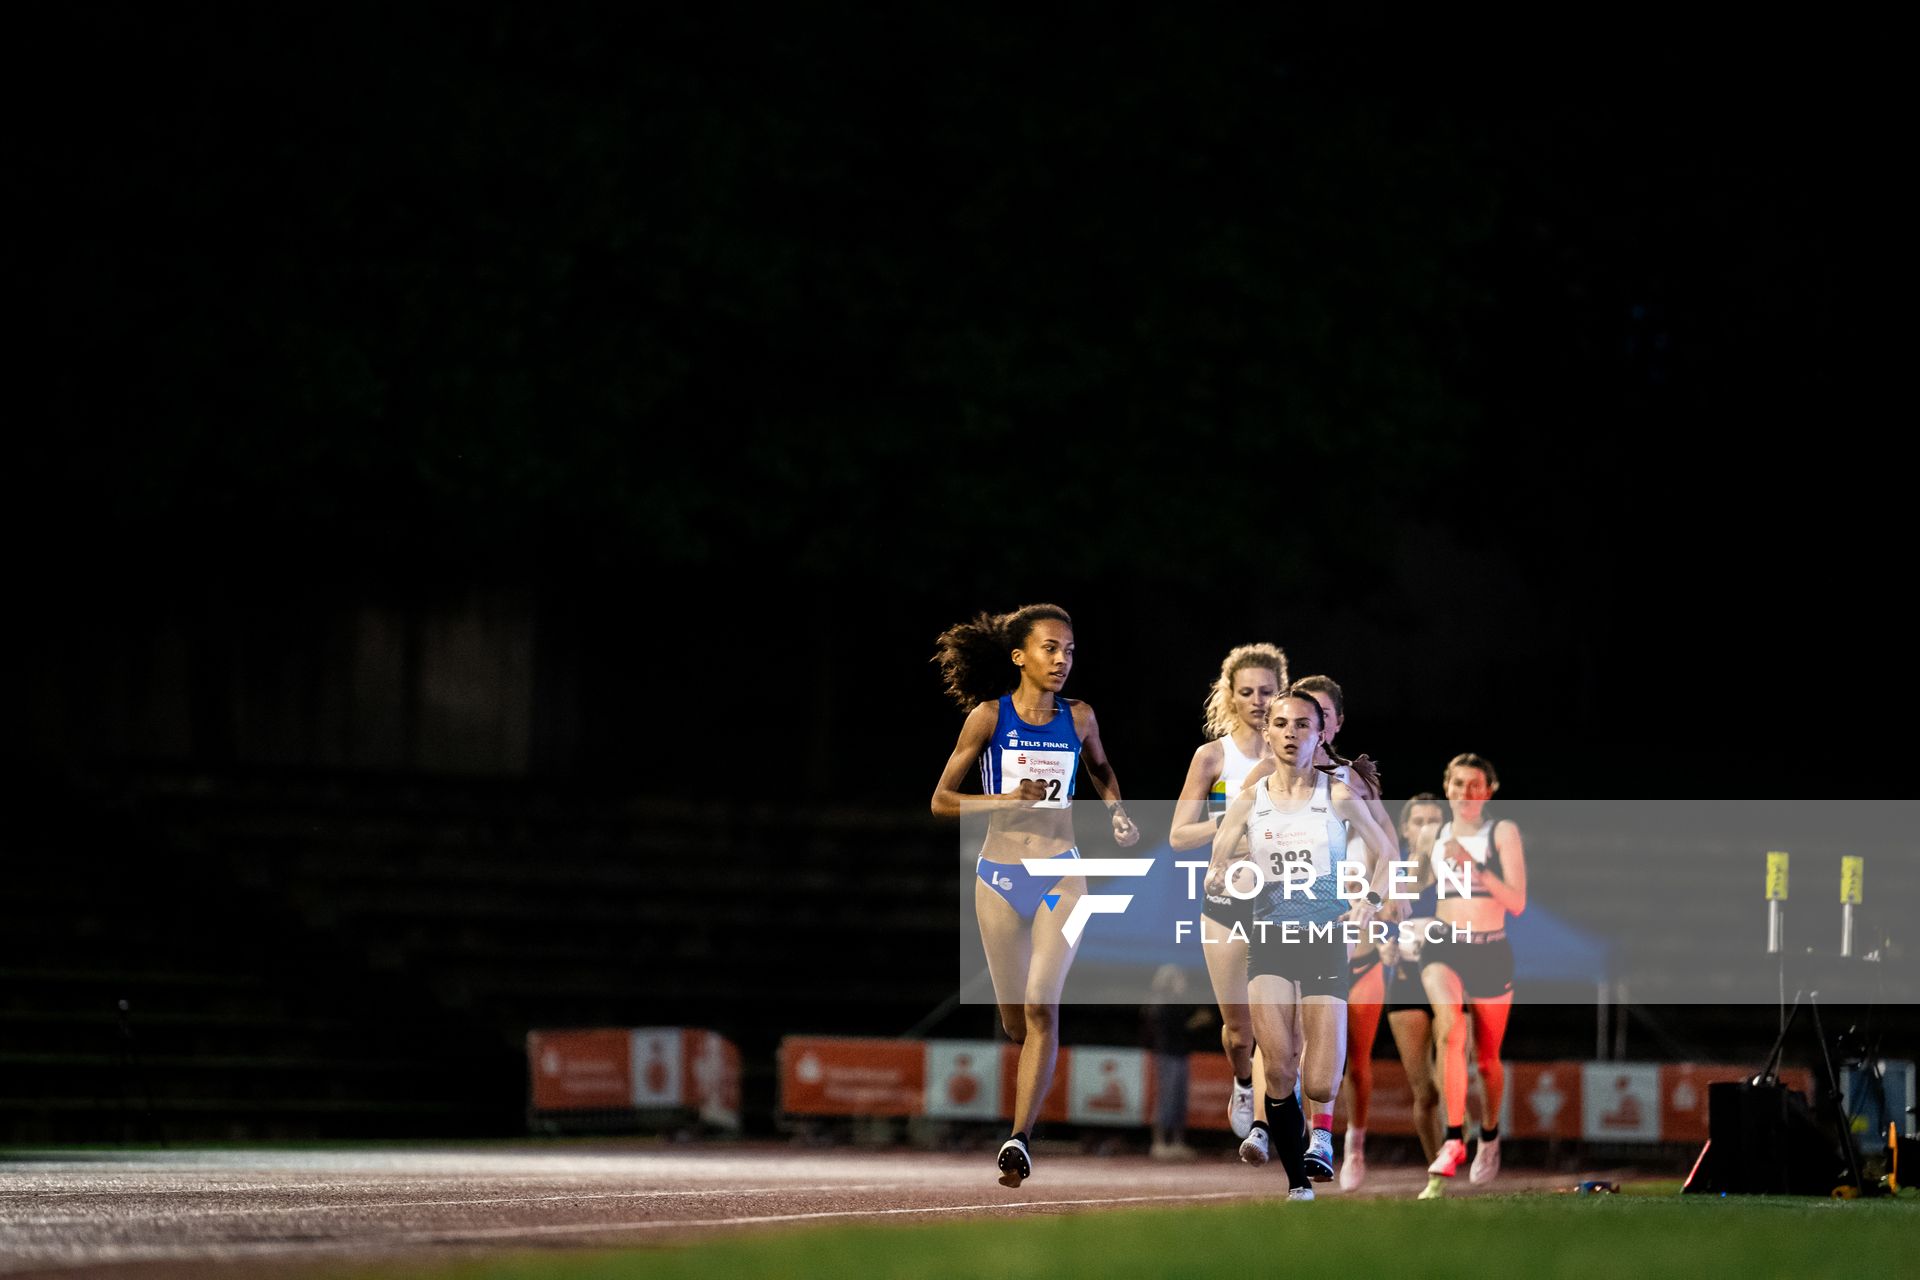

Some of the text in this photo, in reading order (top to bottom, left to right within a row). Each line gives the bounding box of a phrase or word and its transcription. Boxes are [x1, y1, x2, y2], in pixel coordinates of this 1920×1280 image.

[1043, 741, 1069, 749] FINANZ
[1030, 758, 1060, 768] Sparkasse
[1029, 766, 1066, 776] Regensburg
